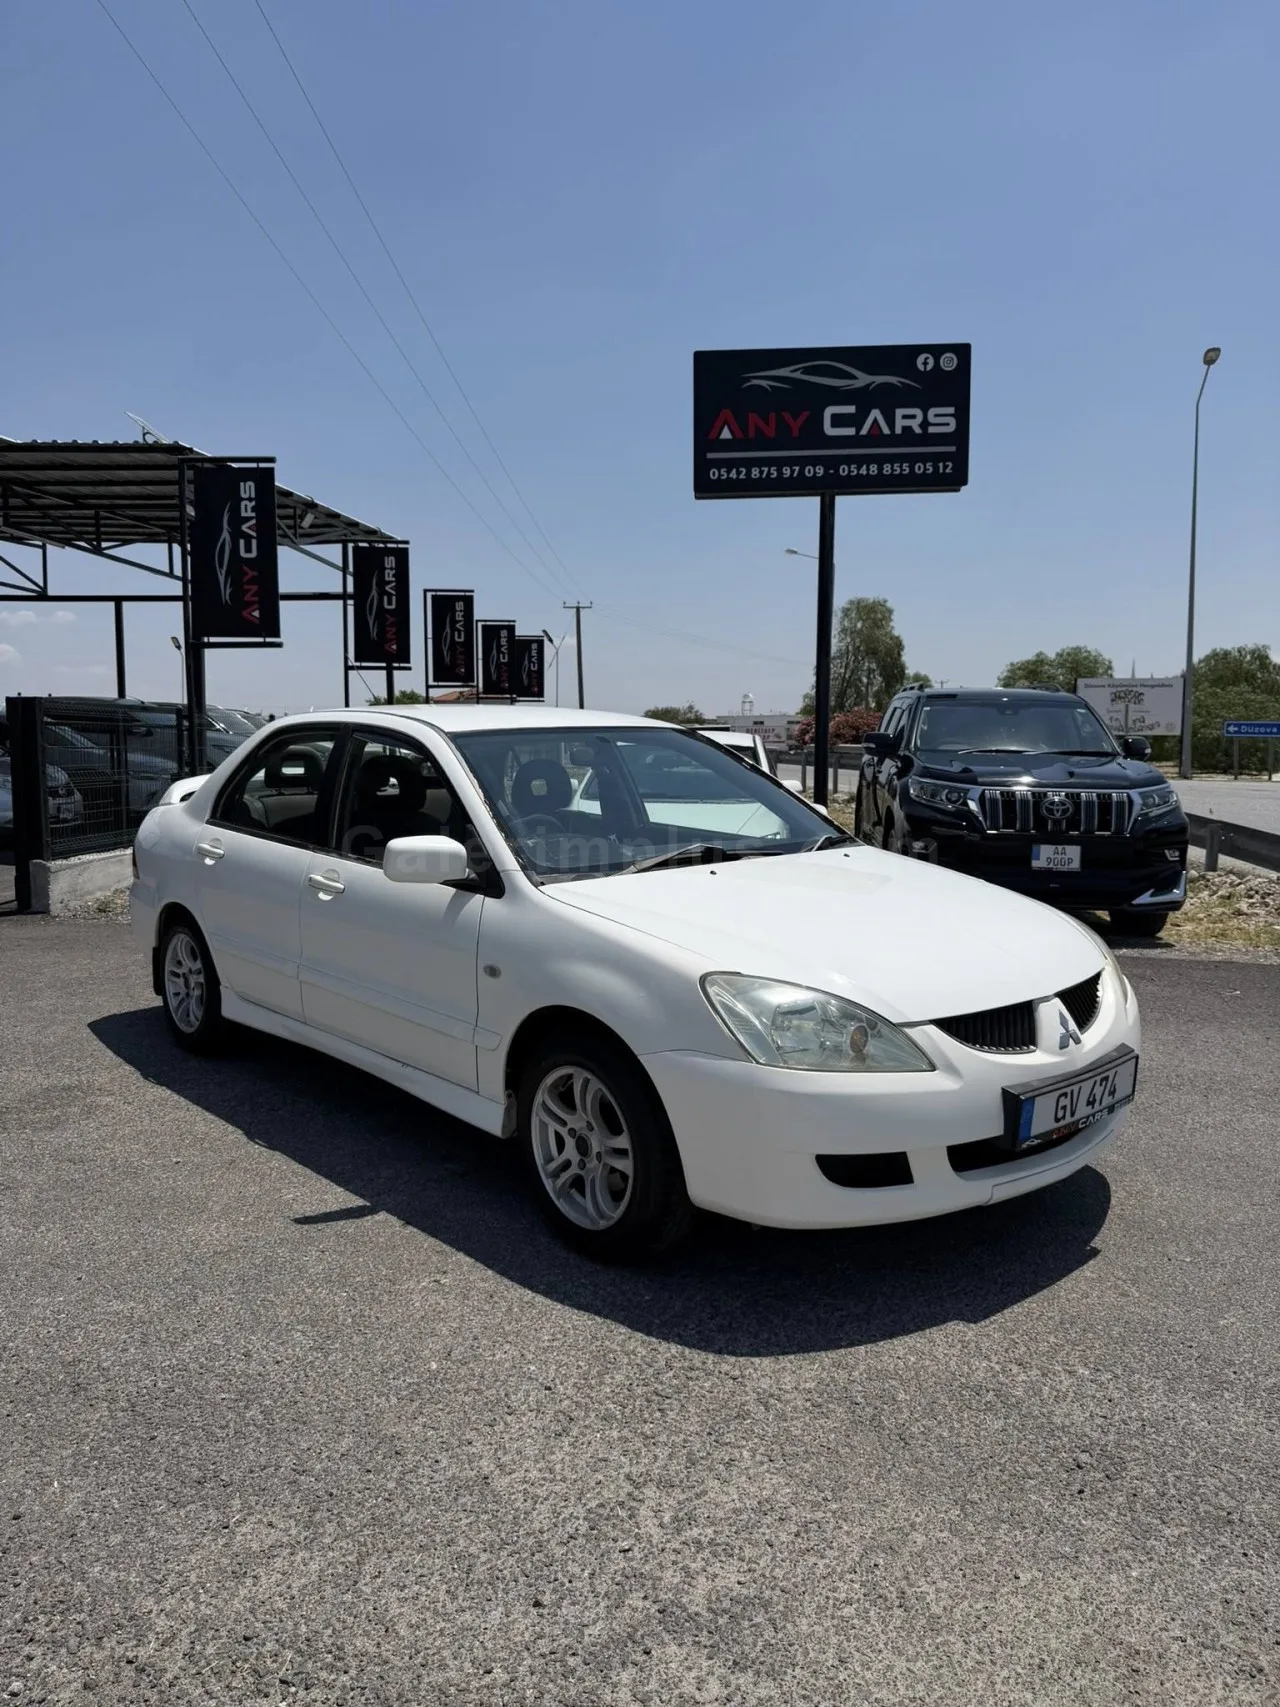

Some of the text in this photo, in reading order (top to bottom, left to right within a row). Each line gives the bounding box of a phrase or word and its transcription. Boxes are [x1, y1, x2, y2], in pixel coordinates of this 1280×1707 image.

[708, 405, 957, 440] ANY CARS
[709, 467, 747, 480] 0542
[751, 466, 778, 479] 875
[782, 465, 800, 478] 97
[804, 464, 825, 477] 09
[839, 463, 878, 476] 0548
[883, 462, 910, 475] 855
[914, 462, 934, 474] 05
[938, 461, 954, 473] 12
[239, 481, 260, 625] ANY CARS
[383, 556, 397, 654] ANY CARS
[454, 601, 465, 677] ANY CARS
[499, 629, 508, 662] CARS
[530, 642, 538, 670] CARS
[1052, 846, 1067, 856] AA
[1054, 1085, 1082, 1123] GV
[1085, 1070, 1118, 1110] 474
[1078, 1109, 1109, 1129] CARS
